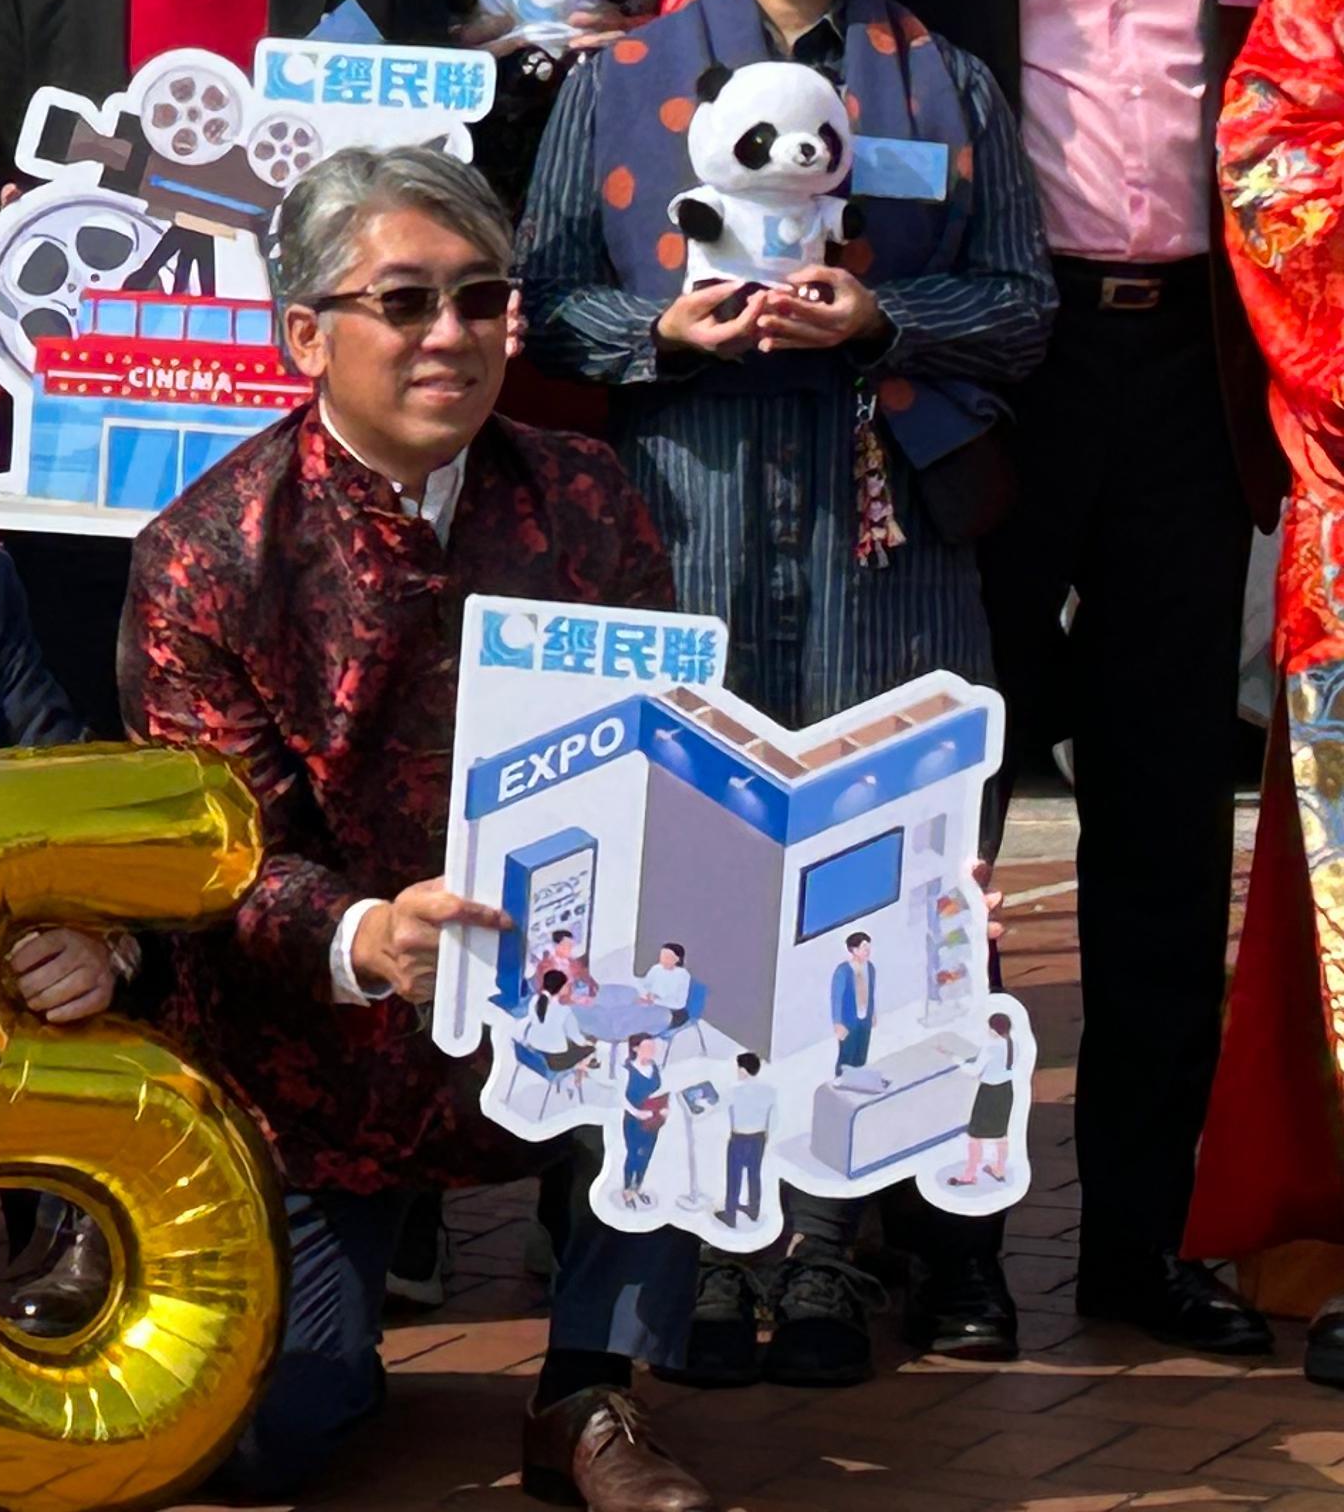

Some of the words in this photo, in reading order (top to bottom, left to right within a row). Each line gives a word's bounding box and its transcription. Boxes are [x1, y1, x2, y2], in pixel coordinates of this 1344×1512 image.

[322, 52, 487, 112] 經民聯
[127, 364, 233, 395] CINEMA
[541, 614, 718, 685] 經民聯
[496, 716, 627, 802] EXPO
